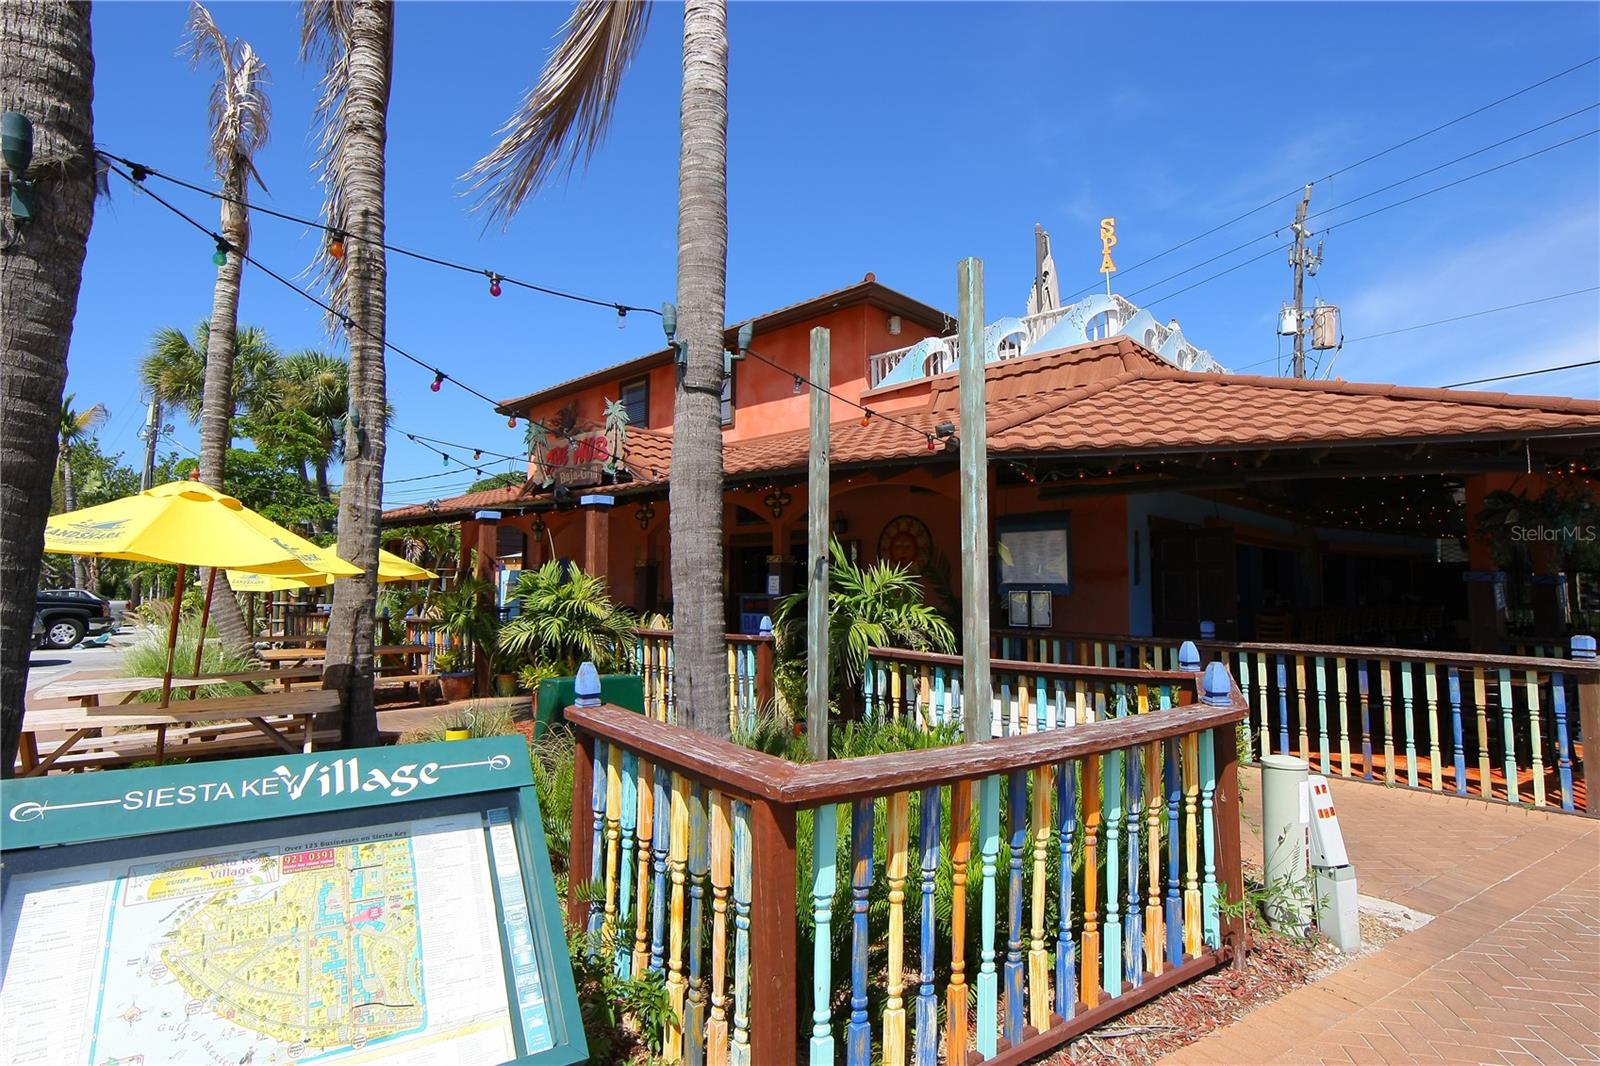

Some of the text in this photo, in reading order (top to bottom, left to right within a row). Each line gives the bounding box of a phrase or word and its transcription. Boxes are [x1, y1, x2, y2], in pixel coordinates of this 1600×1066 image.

[1100, 218, 1117, 272] SPA
[123, 757, 440, 811] SIESTA KEY Village
[320, 836, 359, 848] Businesses
[372, 832, 393, 841] Siesta
[209, 865, 254, 880] Village
[157, 1022, 190, 1036] Gulf
